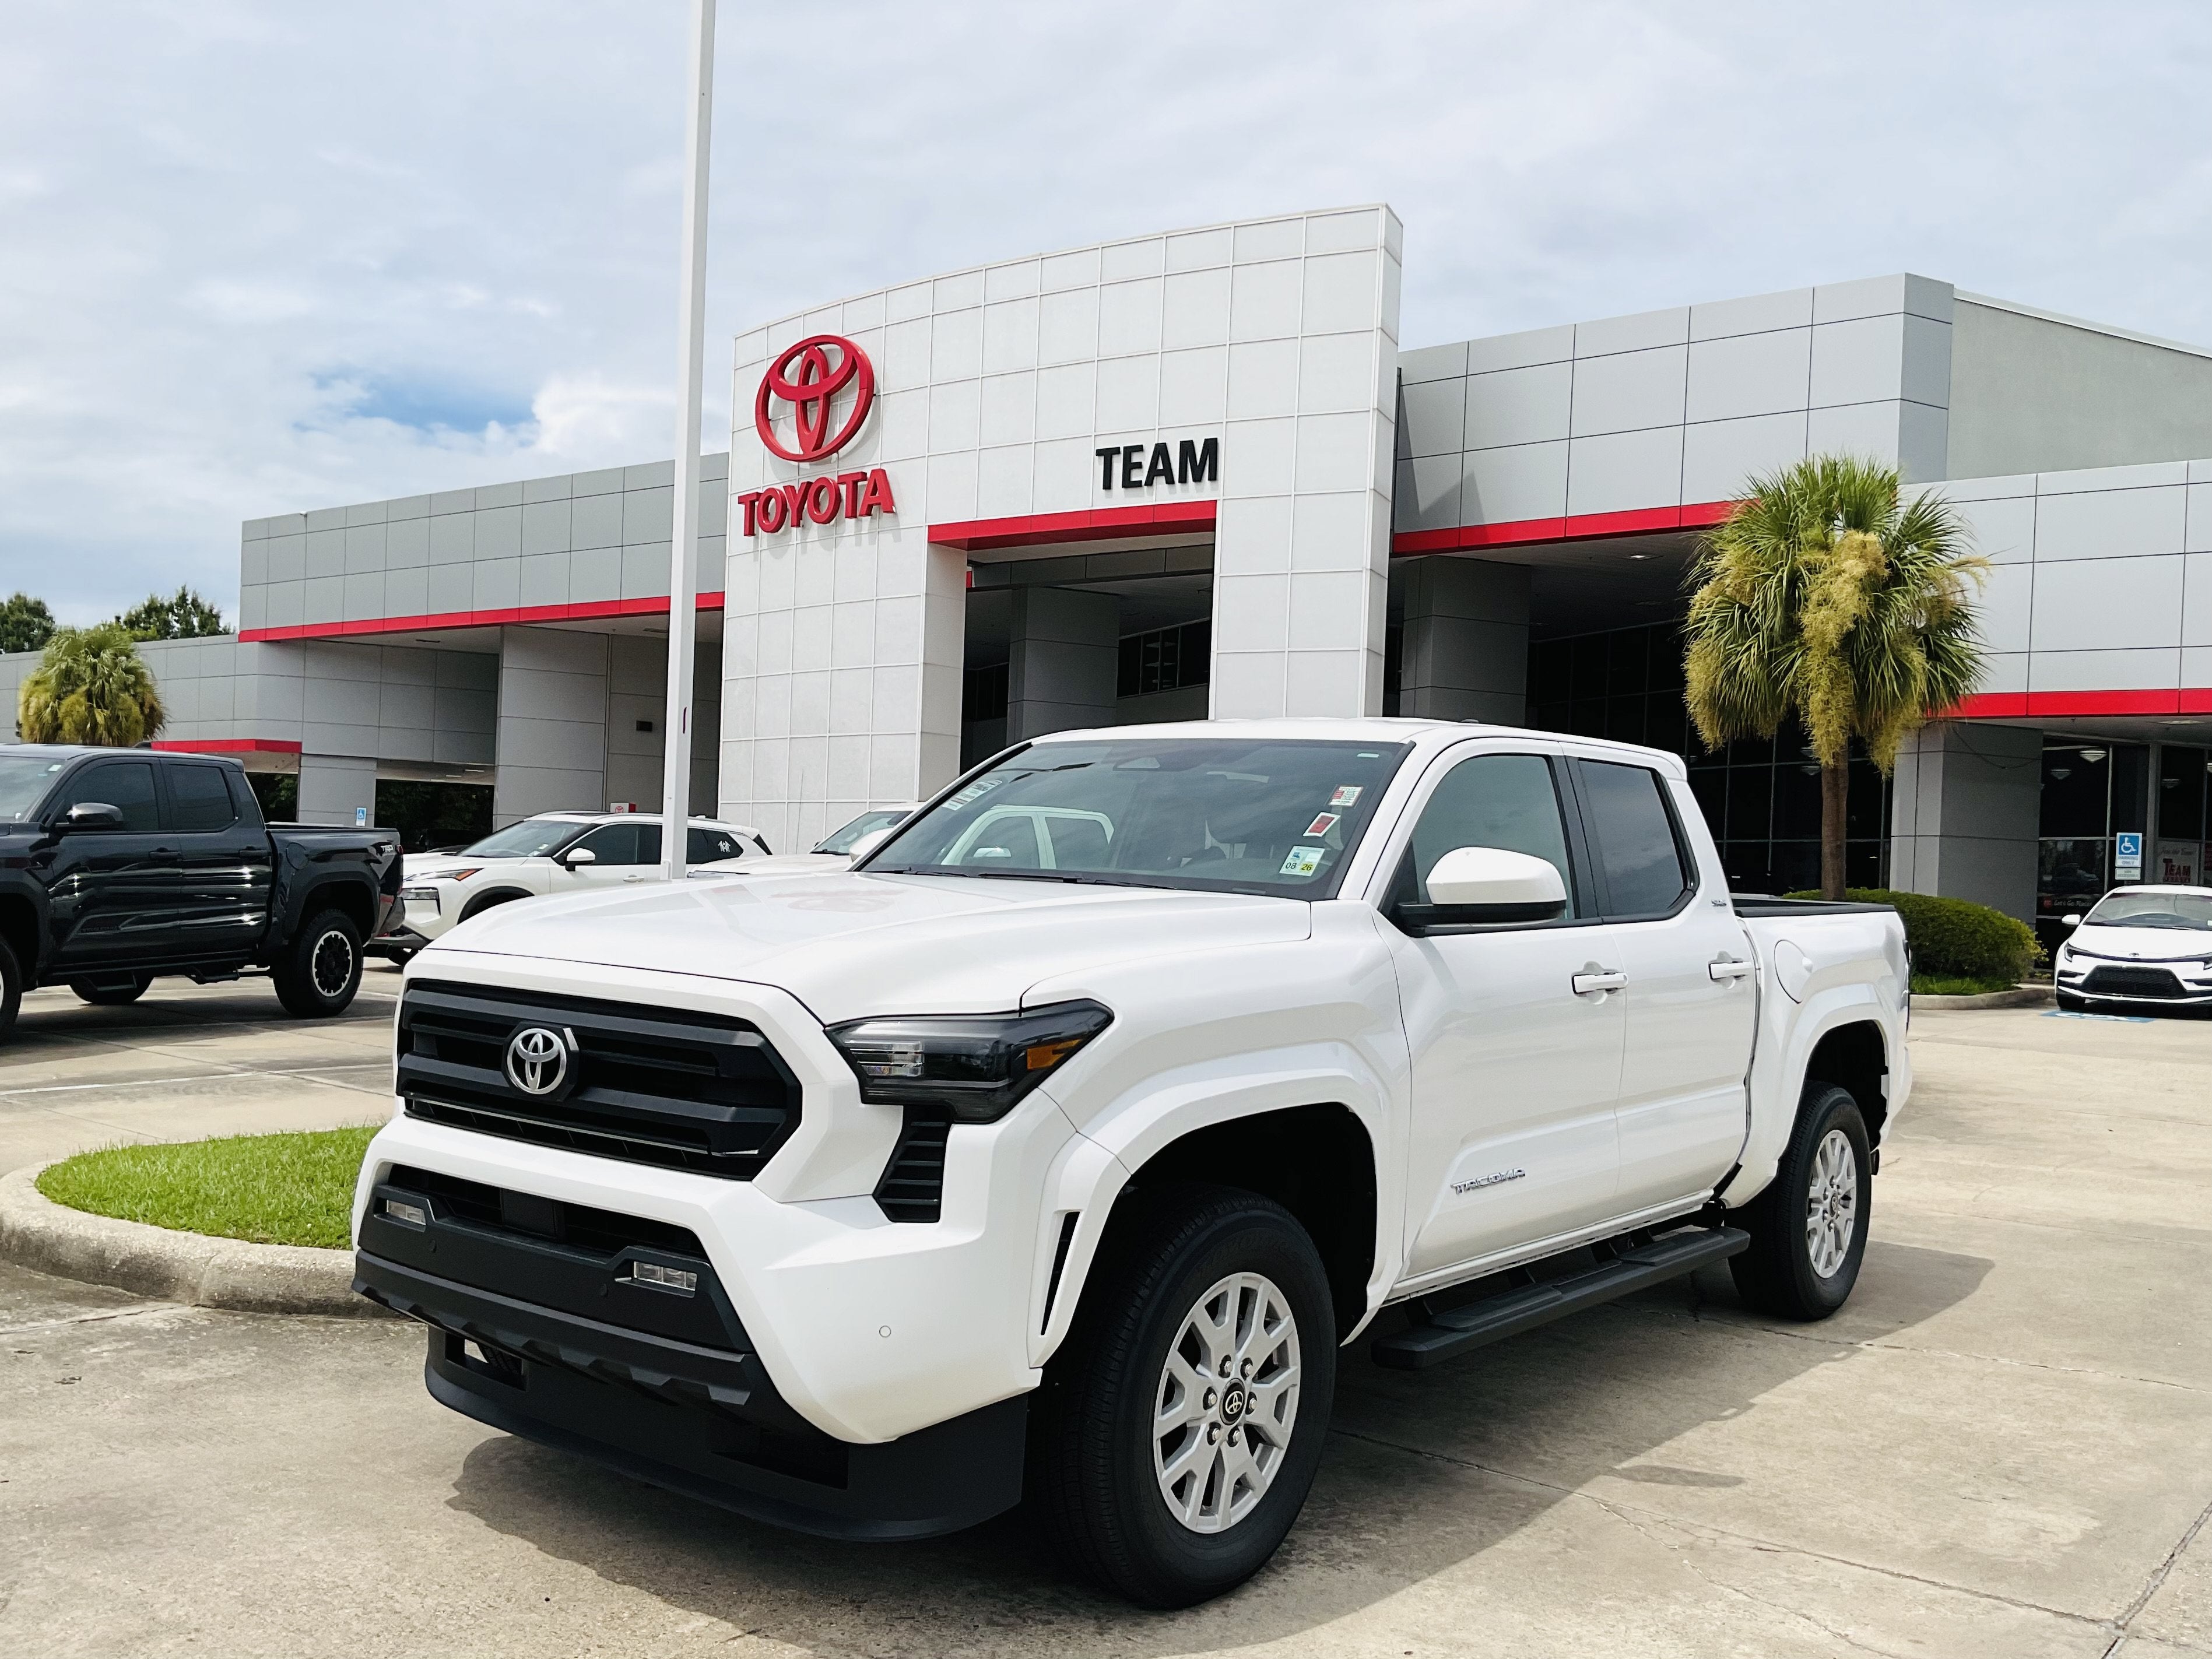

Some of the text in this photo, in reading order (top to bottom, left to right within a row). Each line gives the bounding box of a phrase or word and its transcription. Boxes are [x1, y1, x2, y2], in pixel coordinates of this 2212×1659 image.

[1096, 438, 1219, 490] TEAM
[738, 468, 896, 536] TOYOTA
[1450, 1167, 1525, 1195] TACOMA
